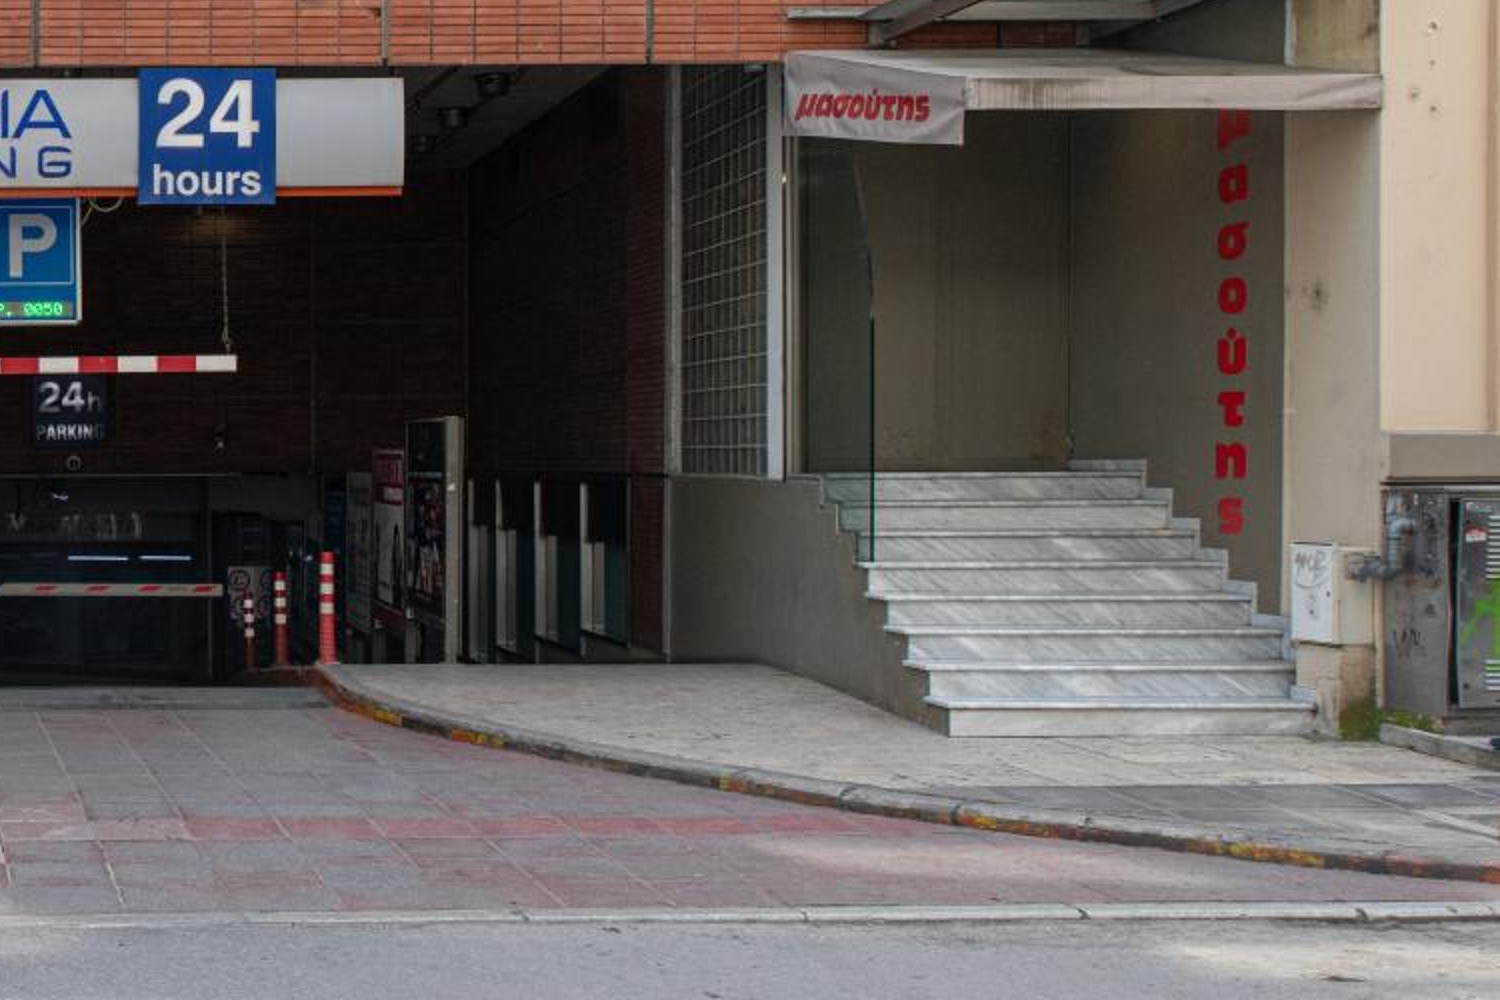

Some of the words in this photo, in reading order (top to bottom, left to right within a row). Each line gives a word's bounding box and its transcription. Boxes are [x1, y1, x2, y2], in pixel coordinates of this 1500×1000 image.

[156, 77, 260, 148] 24
[153, 163, 262, 196] hours
[8, 213, 57, 278] P
